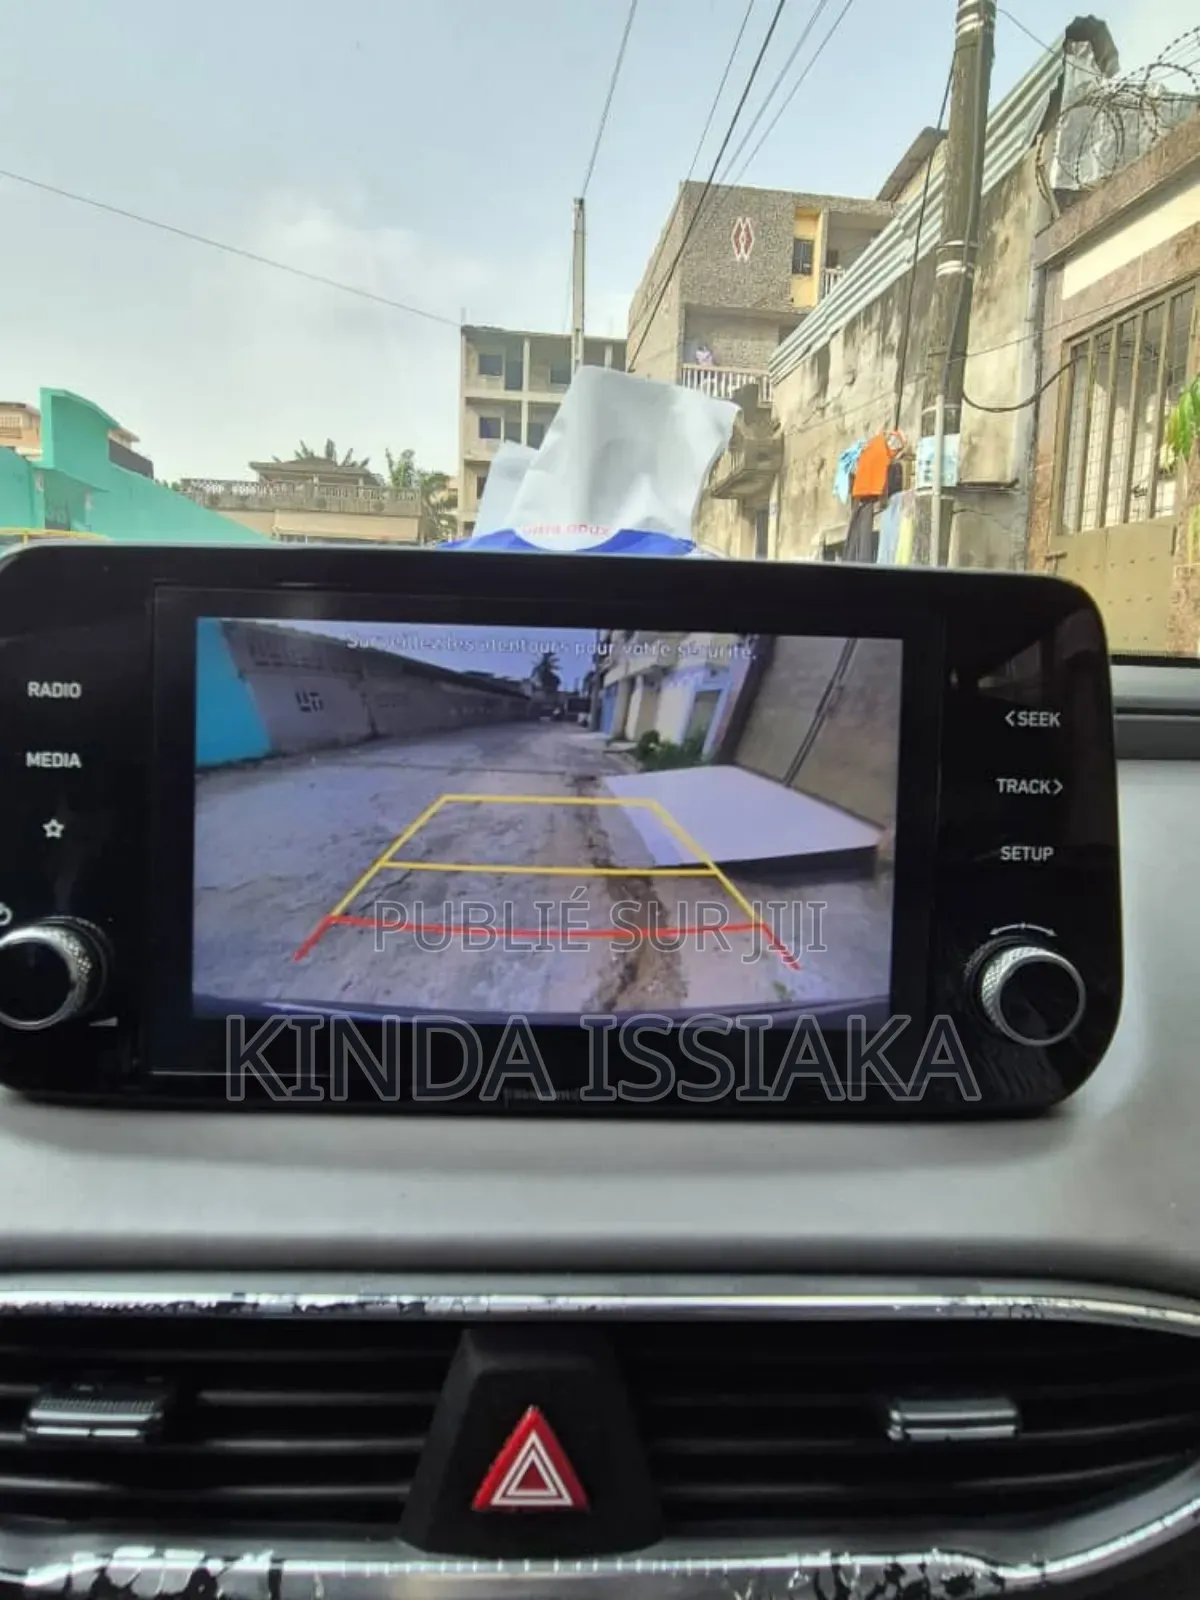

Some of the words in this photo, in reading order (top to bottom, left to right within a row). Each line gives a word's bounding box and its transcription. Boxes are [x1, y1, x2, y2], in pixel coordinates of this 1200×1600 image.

[575, 641, 614, 656] pour
[27, 681, 82, 698] RADIO
[26, 751, 82, 768] MEDIA
[996, 778, 1051, 794] TRACK
[1000, 846, 1054, 861] SETUP
